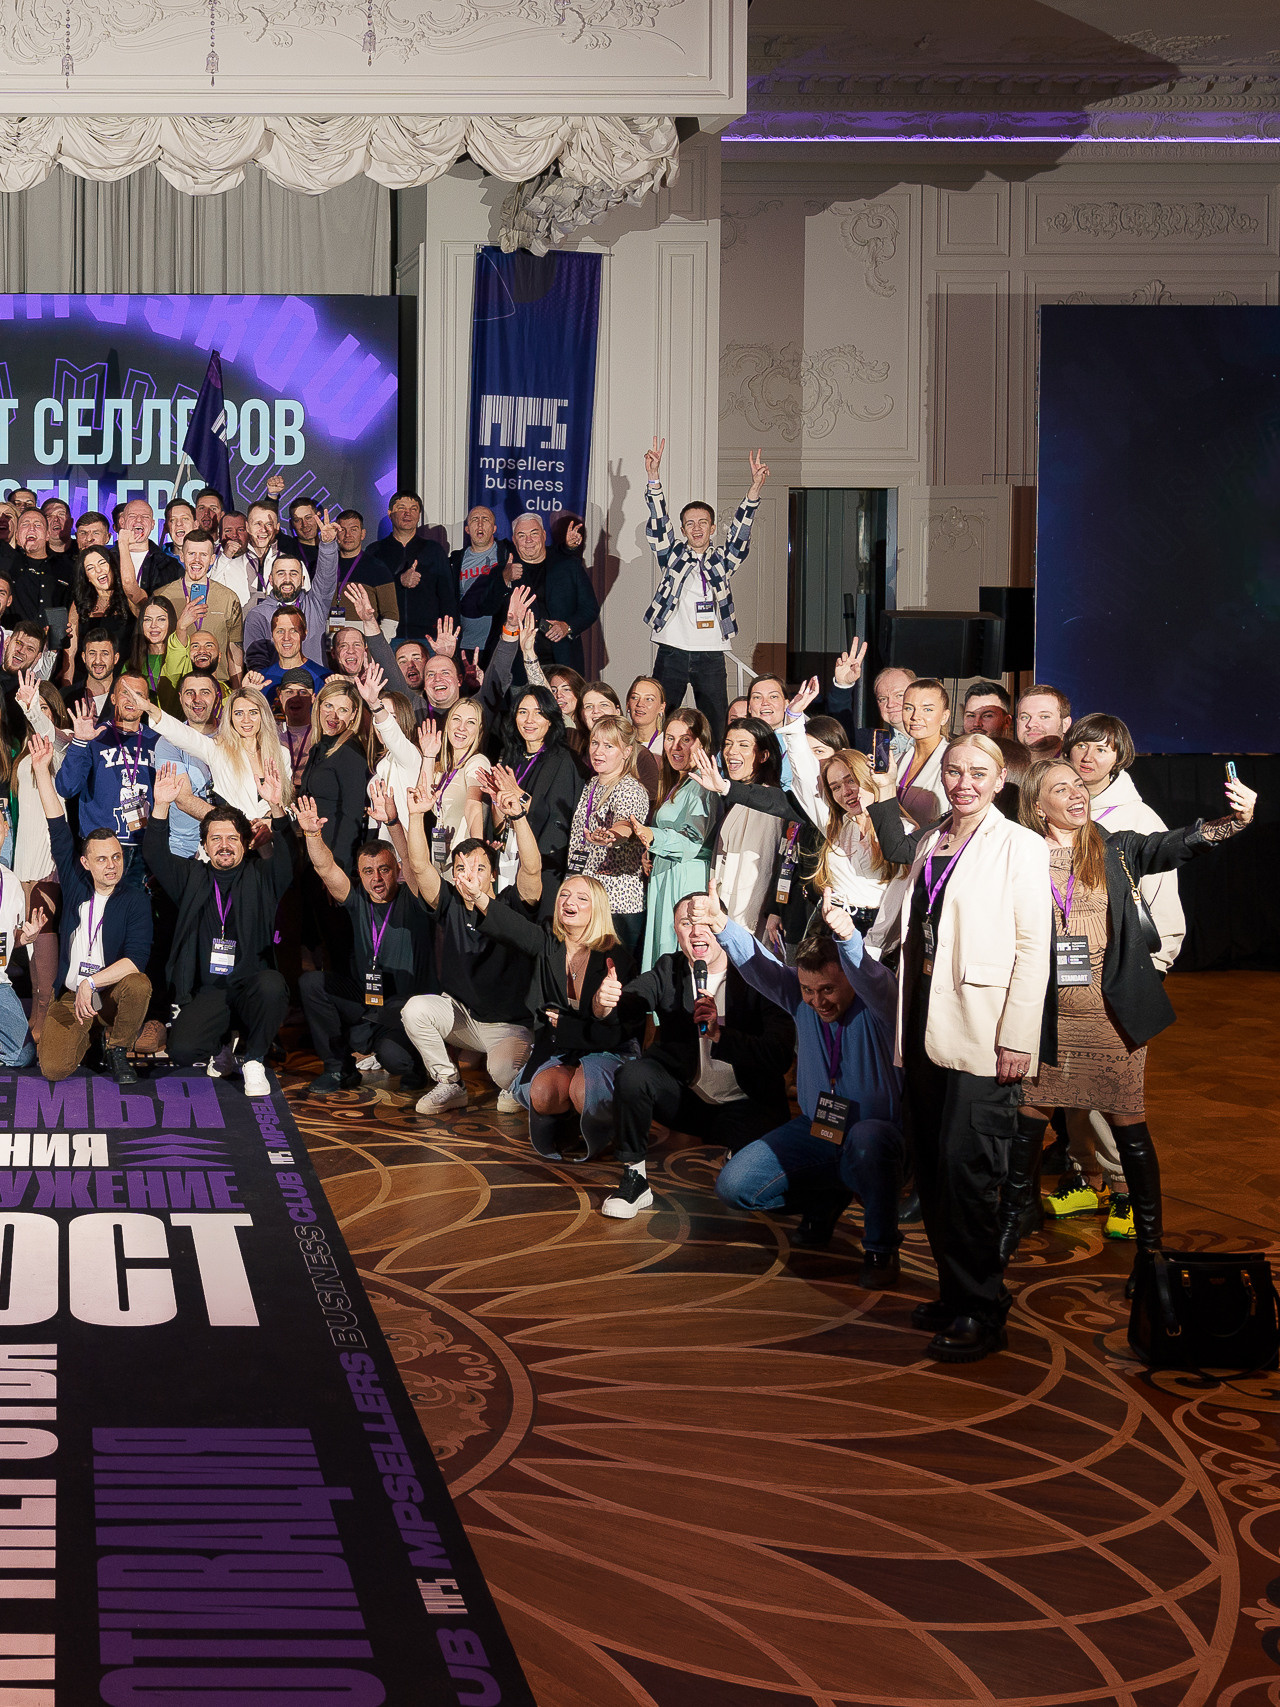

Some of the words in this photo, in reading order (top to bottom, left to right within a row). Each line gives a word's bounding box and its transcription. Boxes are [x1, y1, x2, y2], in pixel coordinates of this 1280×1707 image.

[479, 456, 565, 473] mpsellers
[485, 475, 564, 492] business
[525, 497, 563, 512] club
[250, 1095, 290, 1149] MPSEL
[820, 1129, 834, 1139] GOLD
[275, 1171, 318, 1223] CLUB
[294, 1224, 368, 1349] BUSINESS
[339, 1351, 453, 1570] MPSELLERS
[436, 1628, 502, 1707] UB
